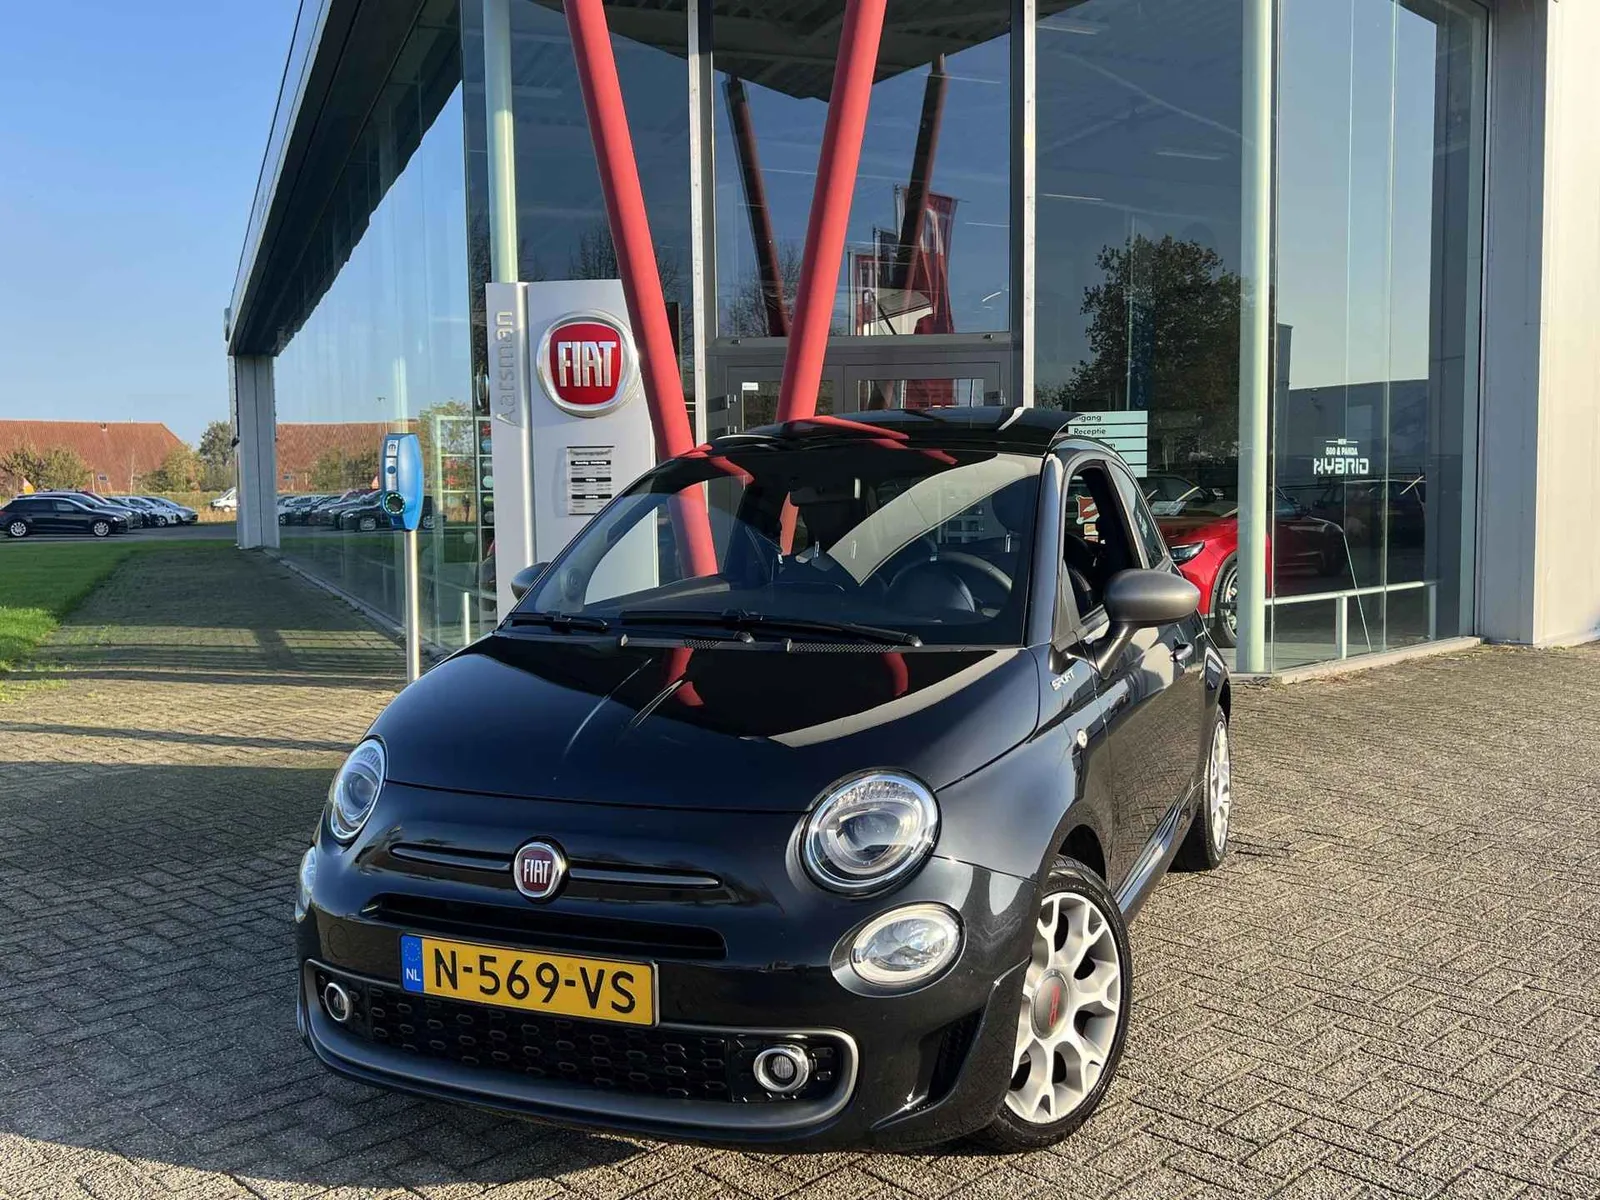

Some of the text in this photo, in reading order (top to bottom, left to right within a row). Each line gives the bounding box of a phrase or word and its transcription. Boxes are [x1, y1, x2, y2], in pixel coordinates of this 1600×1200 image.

[495, 311, 517, 426] Aarsman
[557, 341, 617, 388] FIAT
[1073, 427, 1106, 436] Receptie
[1313, 457, 1369, 475] HYBRID
[1051, 668, 1075, 691] SPORT
[523, 858, 552, 884] FIAT
[406, 968, 421, 982] NL
[434, 948, 636, 1014] N-569-VS
